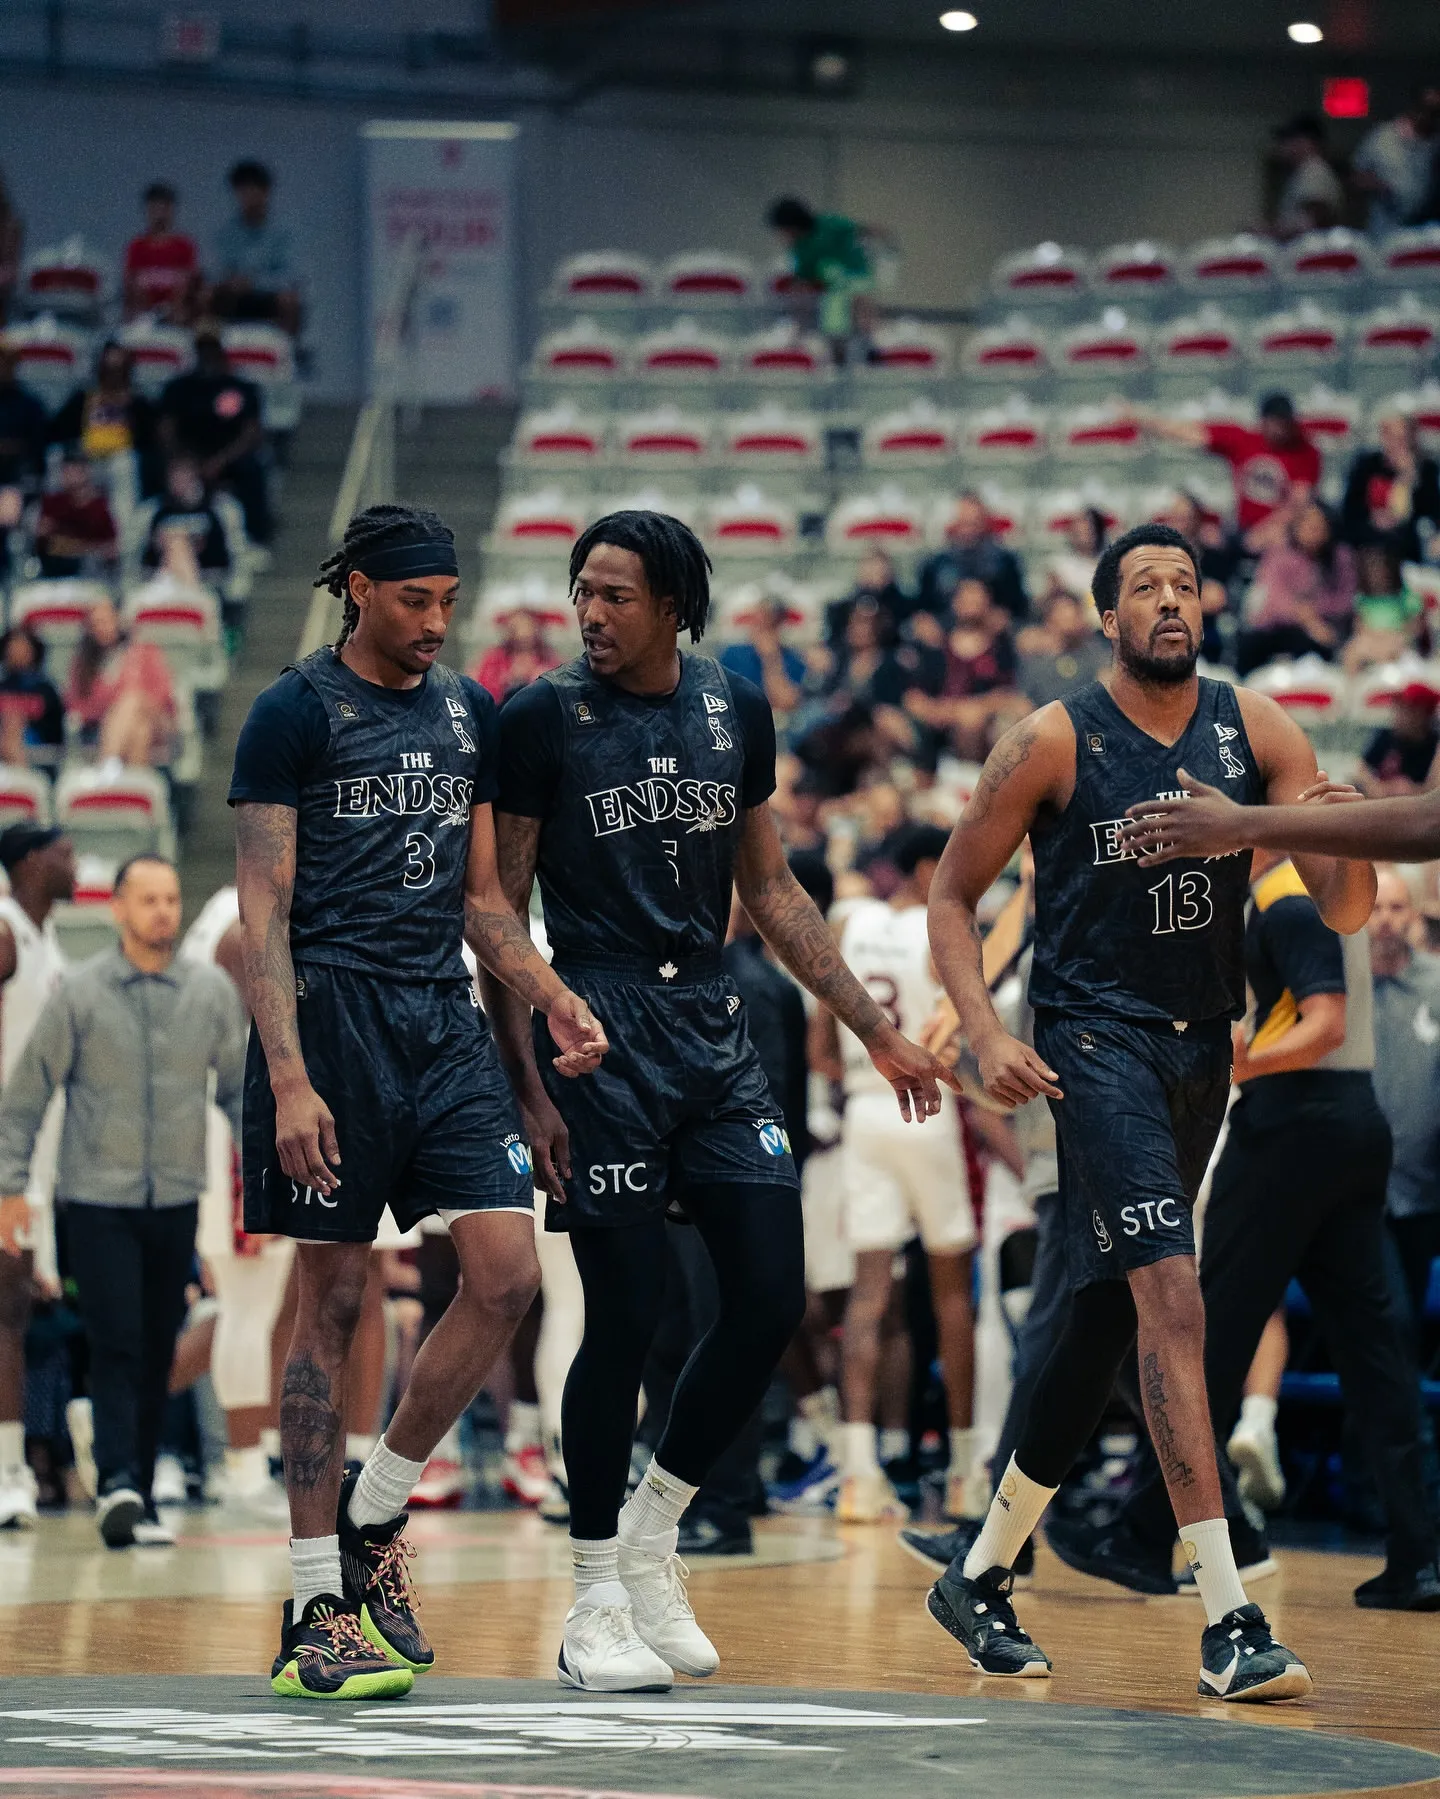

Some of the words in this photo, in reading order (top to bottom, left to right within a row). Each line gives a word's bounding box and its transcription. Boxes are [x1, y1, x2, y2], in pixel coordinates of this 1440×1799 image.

[400, 752, 434, 769] THE
[647, 757, 679, 774] THE
[585, 777, 736, 837] ENDSSS
[403, 831, 435, 889] 3
[1148, 871, 1213, 934] 13
[499, 1132, 520, 1148] Lotto
[589, 1162, 648, 1195] STC
[1120, 1198, 1181, 1236] STC
